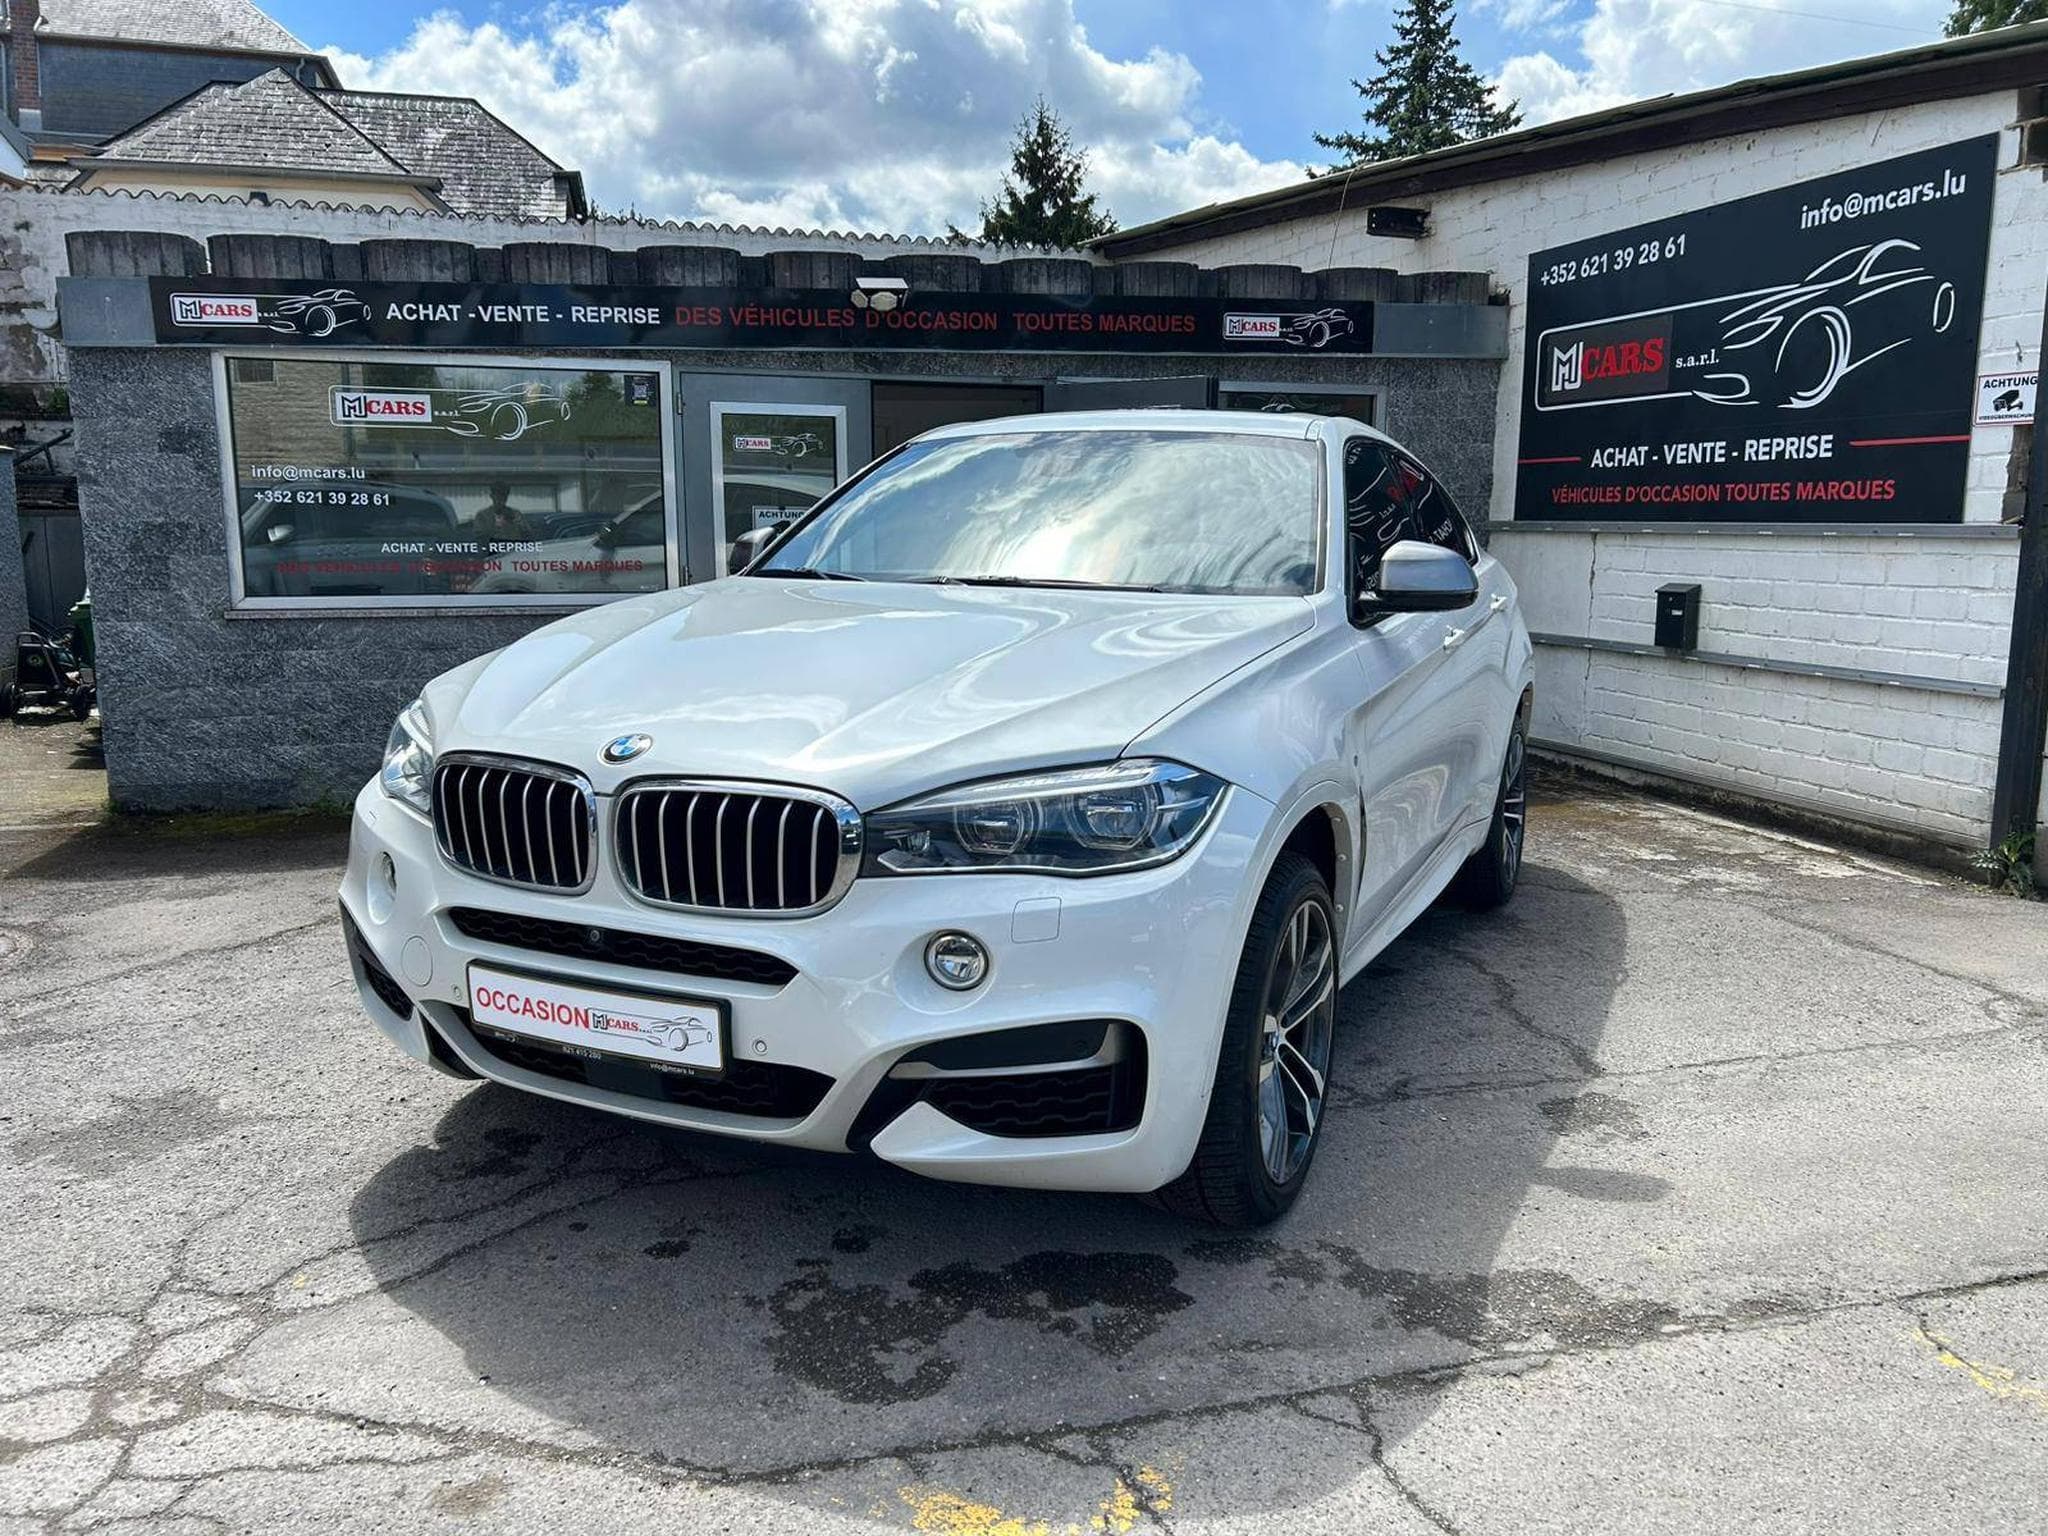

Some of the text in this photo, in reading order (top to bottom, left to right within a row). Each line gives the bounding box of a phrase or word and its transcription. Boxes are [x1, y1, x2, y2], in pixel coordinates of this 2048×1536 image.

[1800, 168, 1966, 230] info@mcars.lu
[1541, 233, 1687, 286] +352 621 39 28 61
[386, 303, 461, 321] ACHAT
[571, 306, 661, 324] REPRISE
[674, 302, 1196, 333] DES VÉHICULES D'OCCASION TOUTES MARQUES
[1675, 348, 1720, 368] s.a.r.l.
[1983, 375, 2038, 389] ACHTUNG
[1590, 446, 1649, 469] ACHAT
[1664, 441, 1727, 465] VENTE
[1744, 434, 1834, 462] REPRISE
[251, 465, 366, 481] info@mcars.lu
[254, 490, 390, 506] +352 621 39 28 61
[1552, 478, 1896, 503] VÉHICULES D'OCCASION TOUTES MARQUES
[381, 543, 425, 553] ACHAT
[436, 542, 478, 553] VENTE
[489, 542, 544, 553] REPRISE
[512, 560, 568, 572] TOUTES
[572, 560, 643, 573] MARQUES
[476, 986, 590, 1030] OCCASION
